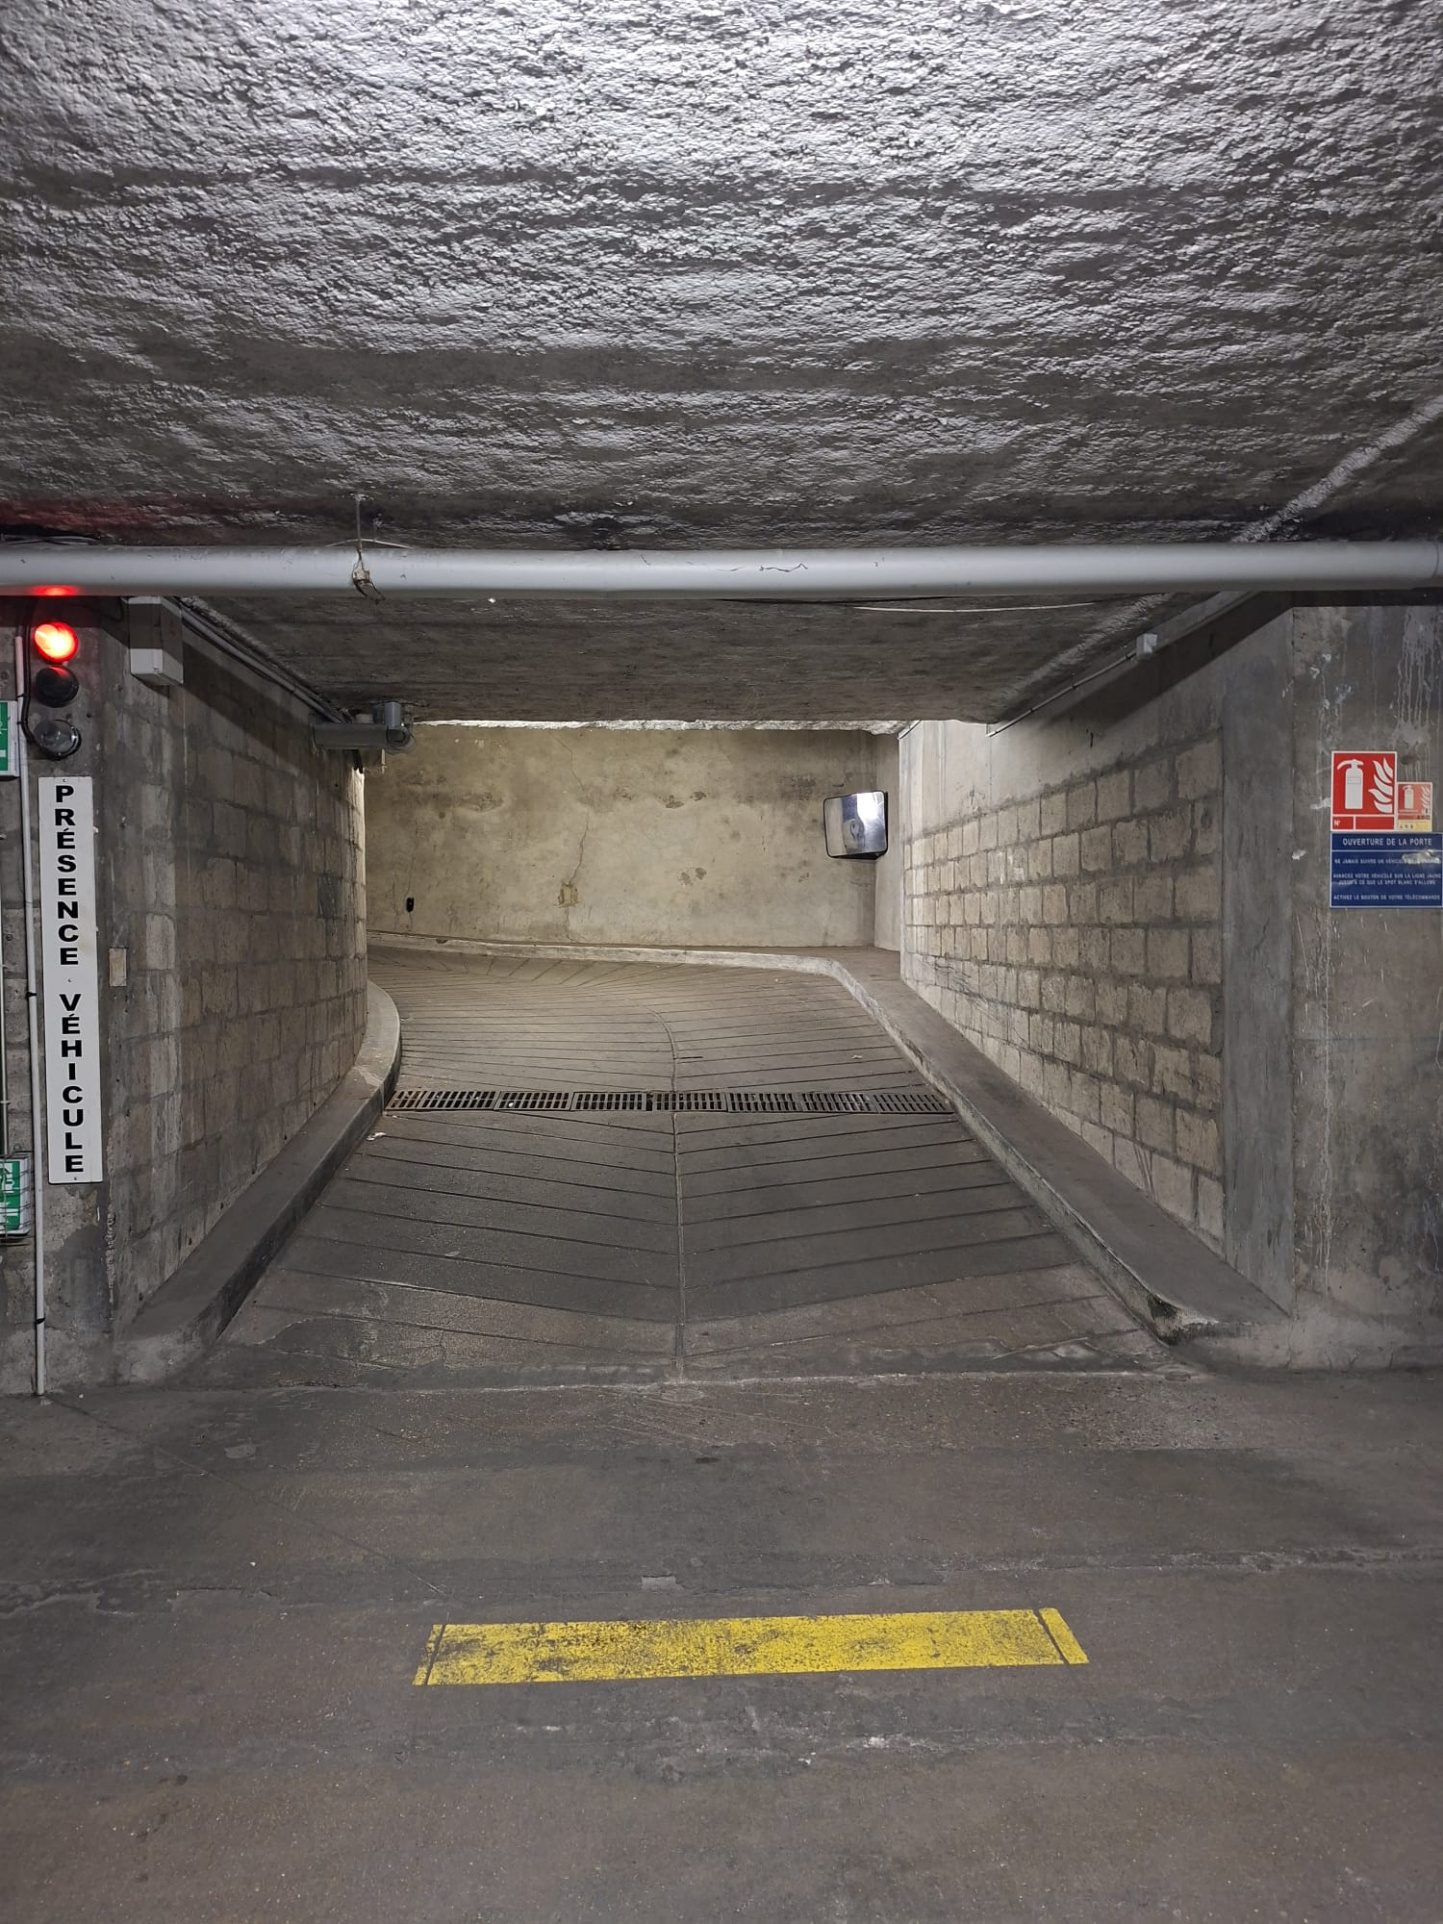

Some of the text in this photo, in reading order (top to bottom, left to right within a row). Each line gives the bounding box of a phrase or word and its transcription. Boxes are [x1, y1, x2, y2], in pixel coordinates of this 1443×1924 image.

[1342, 838, 1432, 846] OUVERTURE DE LA PORTE
[54, 785, 85, 1173] PRÉSENCE VÉHICULE
